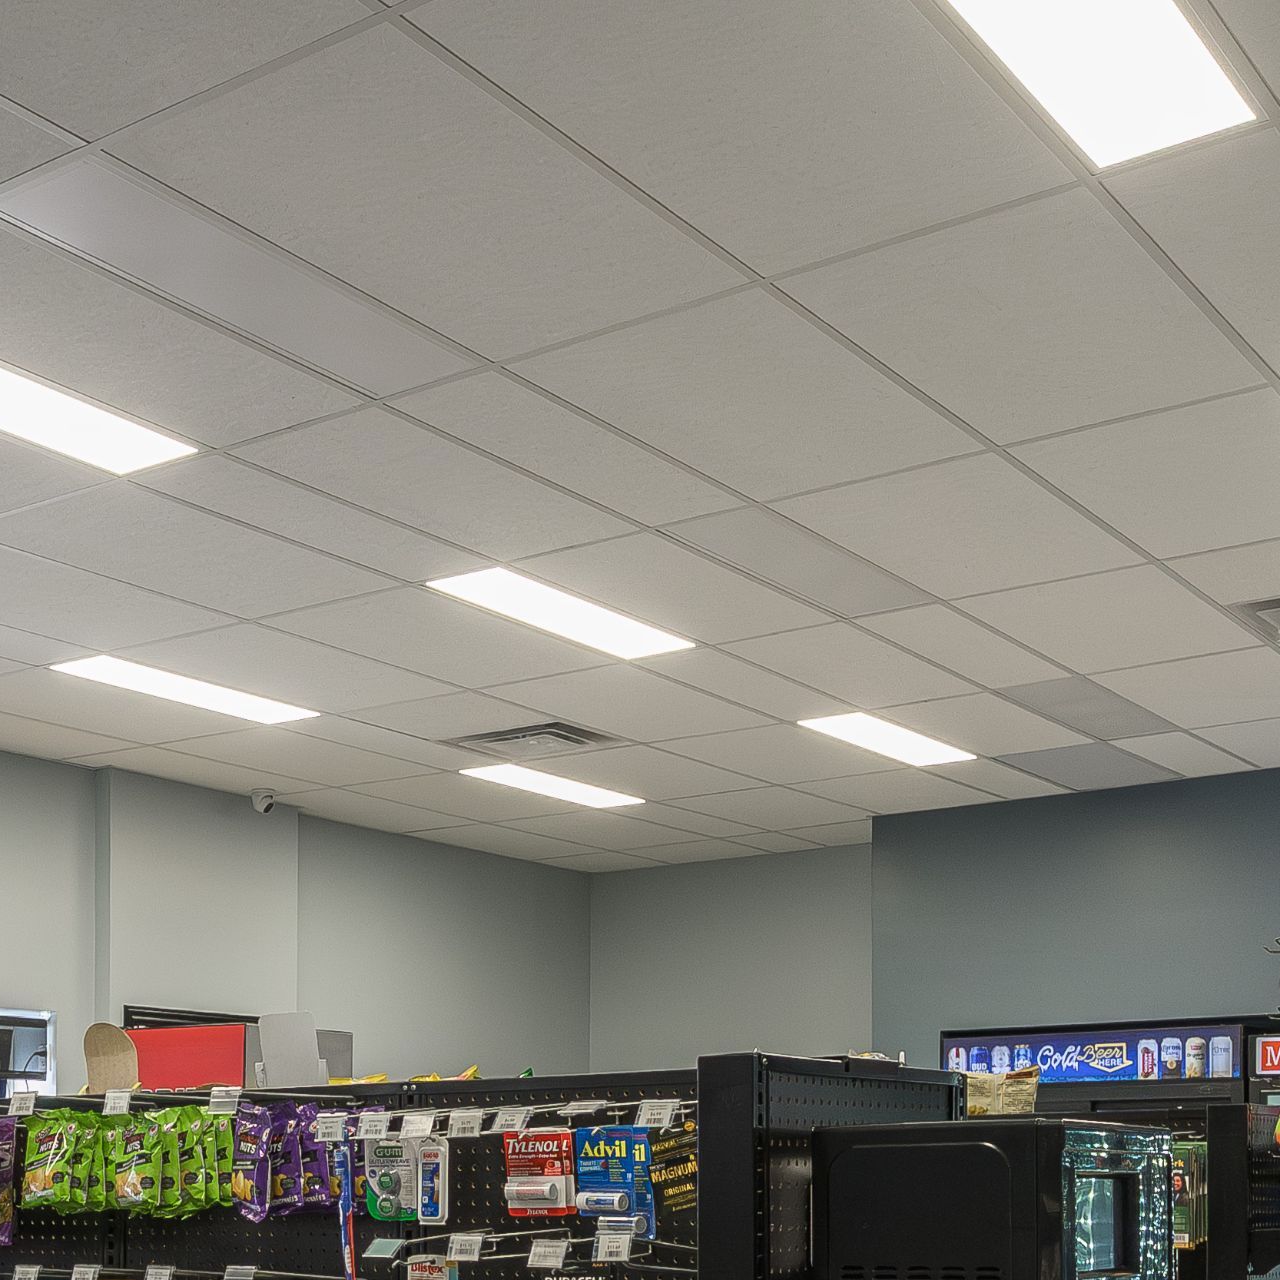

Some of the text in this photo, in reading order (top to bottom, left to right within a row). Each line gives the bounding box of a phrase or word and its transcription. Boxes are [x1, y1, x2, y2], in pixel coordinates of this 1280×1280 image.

[1037, 1045, 1123, 1073] Cold Beer
[1098, 1058, 1121, 1067] HERE
[971, 1063, 987, 1071] BUD
[506, 1139, 560, 1155] TYLENOL
[580, 1140, 627, 1158] Advil
[650, 1160, 698, 1184] MAGNUM
[664, 1183, 696, 1197] ORIGINAL
[410, 1263, 445, 1275] Blistex
